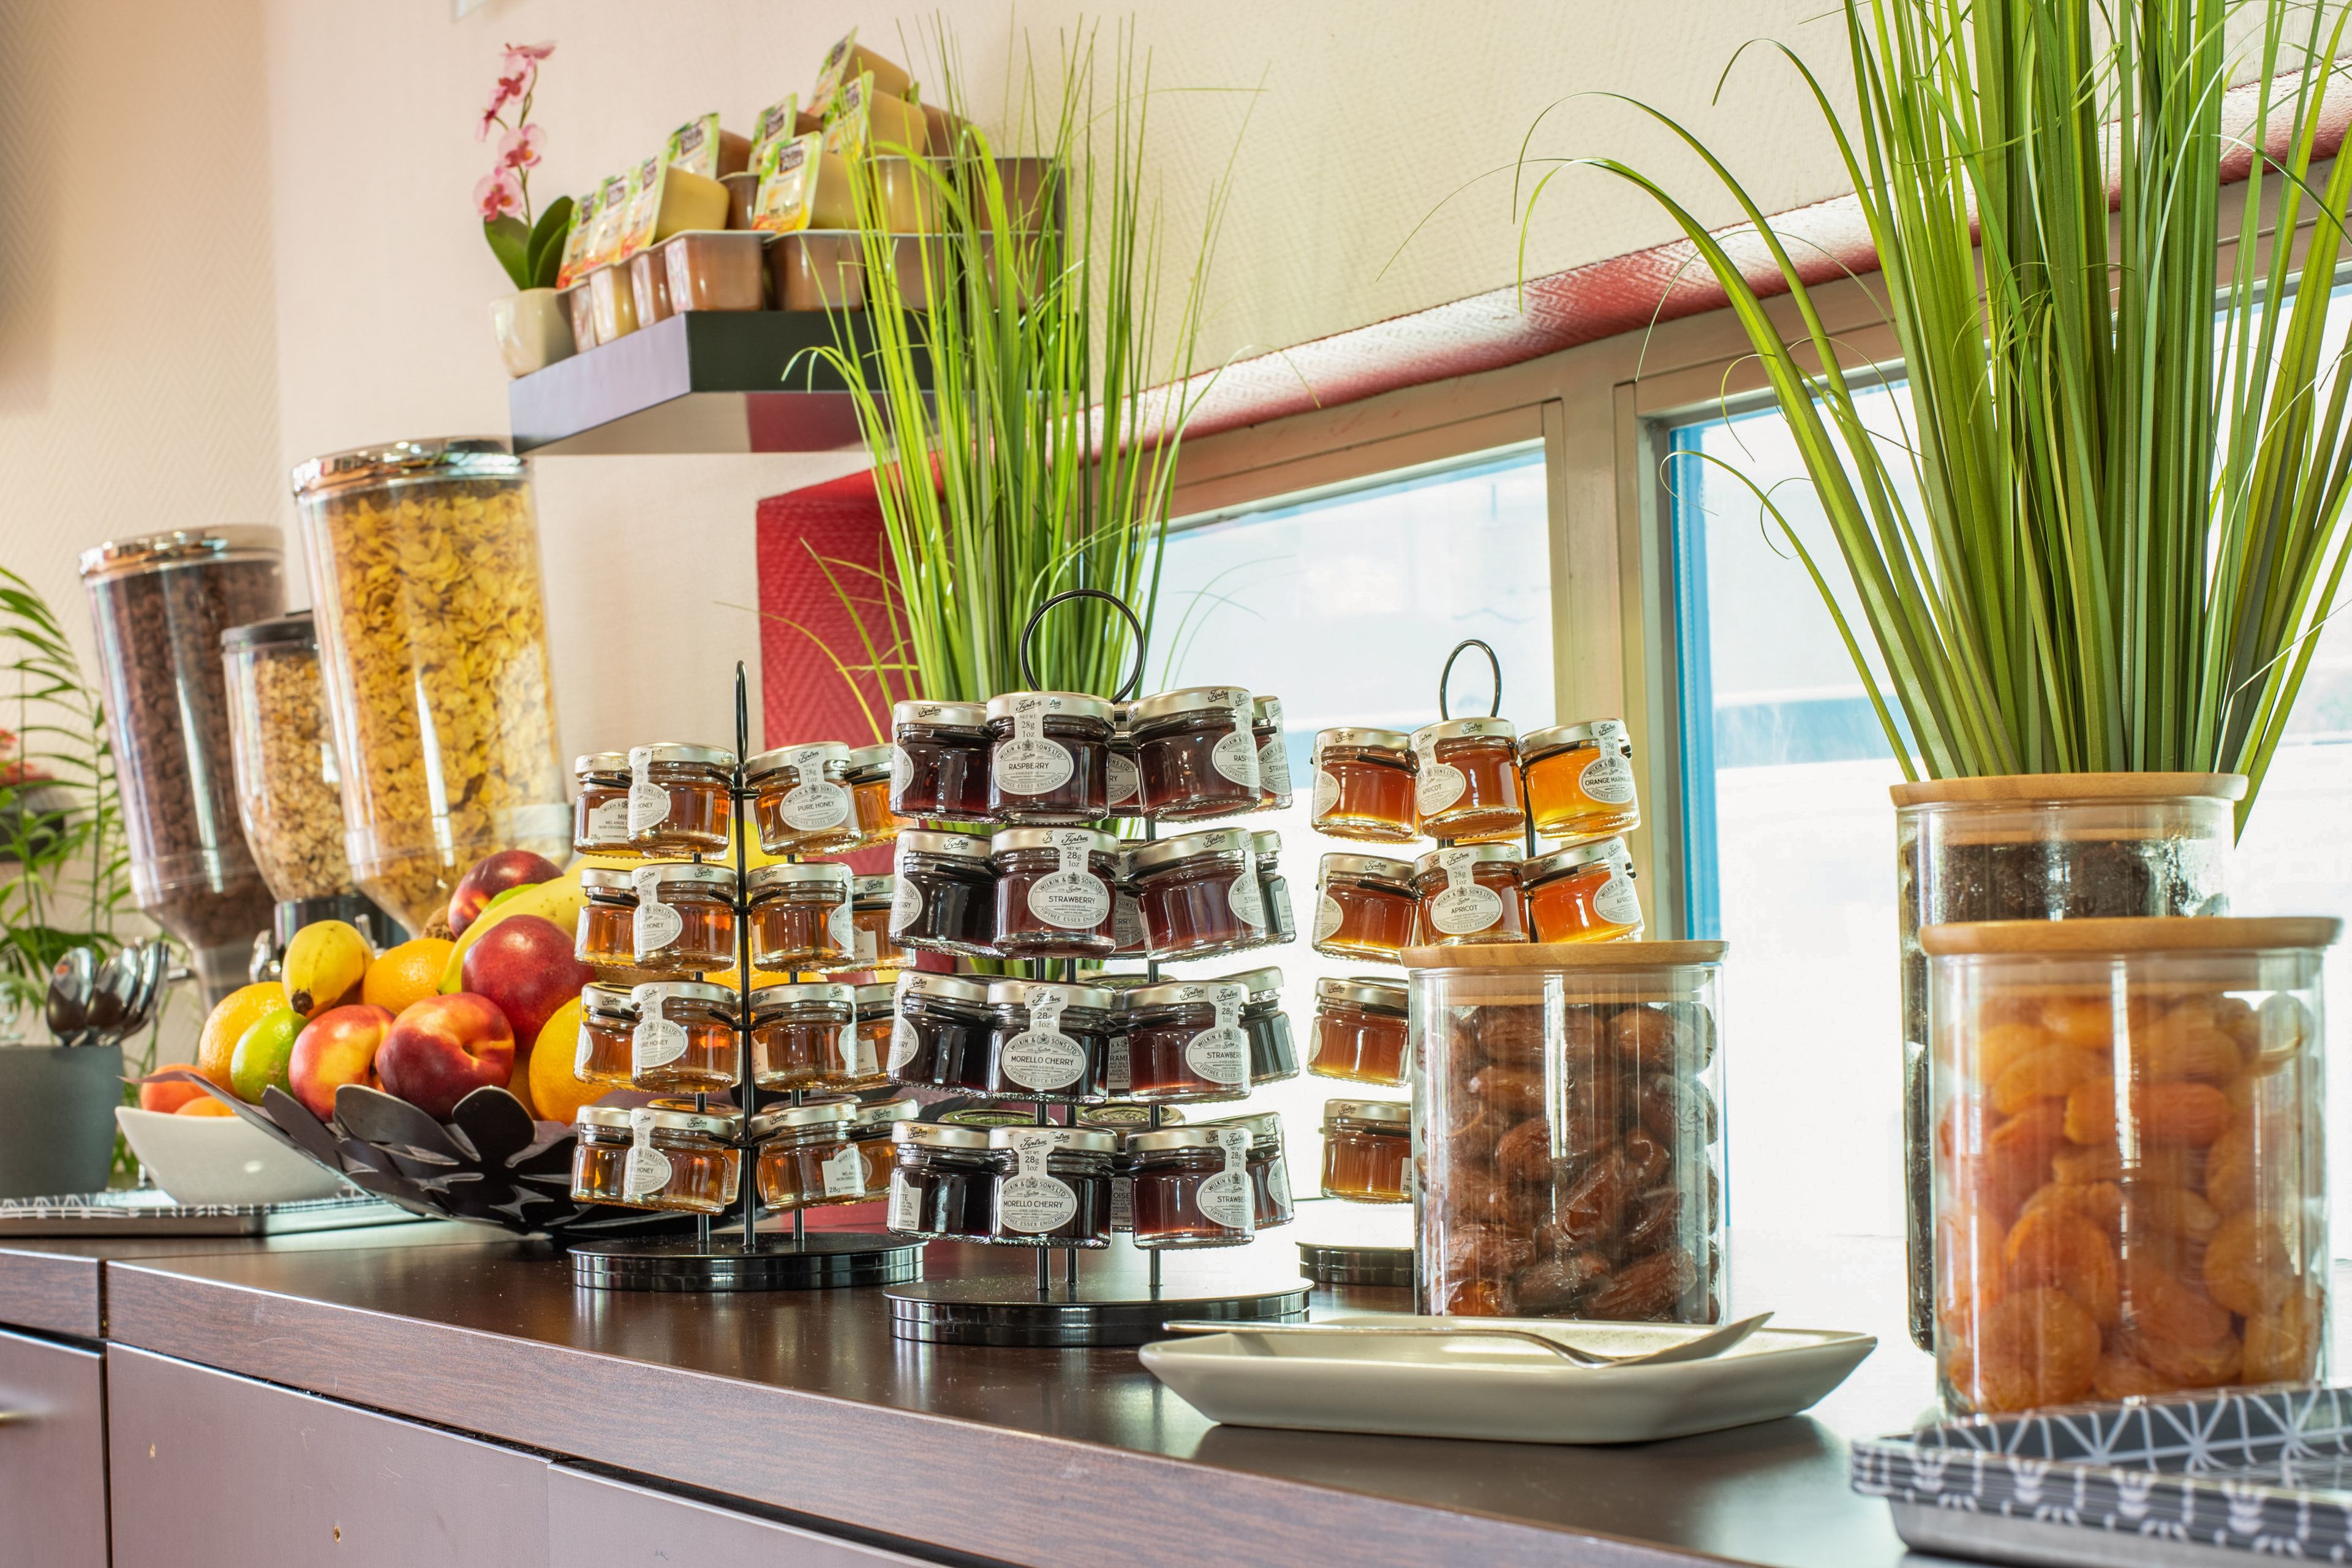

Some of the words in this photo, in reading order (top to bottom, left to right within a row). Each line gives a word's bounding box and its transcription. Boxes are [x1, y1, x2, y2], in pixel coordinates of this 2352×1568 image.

[918, 705, 941, 717] Tiptree
[1015, 699, 1041, 714] Tiptree
[1021, 721, 1035, 729] 28g
[1221, 739, 1237, 750] WILKIN
[798, 751, 820, 764] Tiptree
[1000, 746, 1014, 760] WILKIN
[1036, 744, 1050, 752] SONS
[1052, 749, 1062, 758] LTD
[1120, 763, 1130, 771] LTD
[1588, 764, 1603, 775] WILKIN
[1000, 777, 1015, 788] TIPTREE
[1037, 775, 1062, 788] ENGLAND
[1585, 777, 1610, 786] ORANGE
[1110, 787, 1130, 798] NGLAND
[1422, 784, 1442, 794] APRICOT
[788, 791, 802, 803] WILKIN
[943, 838, 968, 850] Tiptree
[1060, 832, 1088, 845] Tiptree
[1204, 834, 1225, 848] Tiptree
[1067, 851, 1082, 861] 28g
[1447, 853, 1469, 866] Tiptree
[1039, 878, 1059, 891] WILKIN
[1082, 878, 1095, 888] SONS
[1437, 894, 1450, 907] WILKIN
[1041, 908, 1060, 921] TIPTREE
[1084, 910, 1103, 922] ENGLAND
[1451, 905, 1478, 914] APRICOT
[1474, 913, 1495, 927] ENGLAND
[1180, 987, 1205, 1001] Tiptree
[1222, 1008, 1234, 1016] 28g
[1011, 1038, 1028, 1050] WILKIN
[1052, 1038, 1066, 1047] SONS
[1067, 1045, 1077, 1055] LTD
[1197, 1034, 1216, 1047] WILKIN
[1009, 1068, 1027, 1080] TIPTREE
[1051, 1071, 1075, 1083] ENGLAND
[1199, 1065, 1219, 1076] TIPTREE
[1019, 1137, 1047, 1150] Tiptree
[1025, 1156, 1039, 1164] 28g
[1231, 1152, 1242, 1161] 28g
[1003, 1183, 1018, 1194] WILKIN
[1039, 1182, 1055, 1191] SONS
[1055, 1188, 1066, 1197] LTD
[1208, 1178, 1226, 1191] WILKIN
[1003, 1213, 1018, 1225] TIPTREE
[1040, 1213, 1065, 1226] ENGLAND
[1209, 1207, 1229, 1221] TIPTREE
